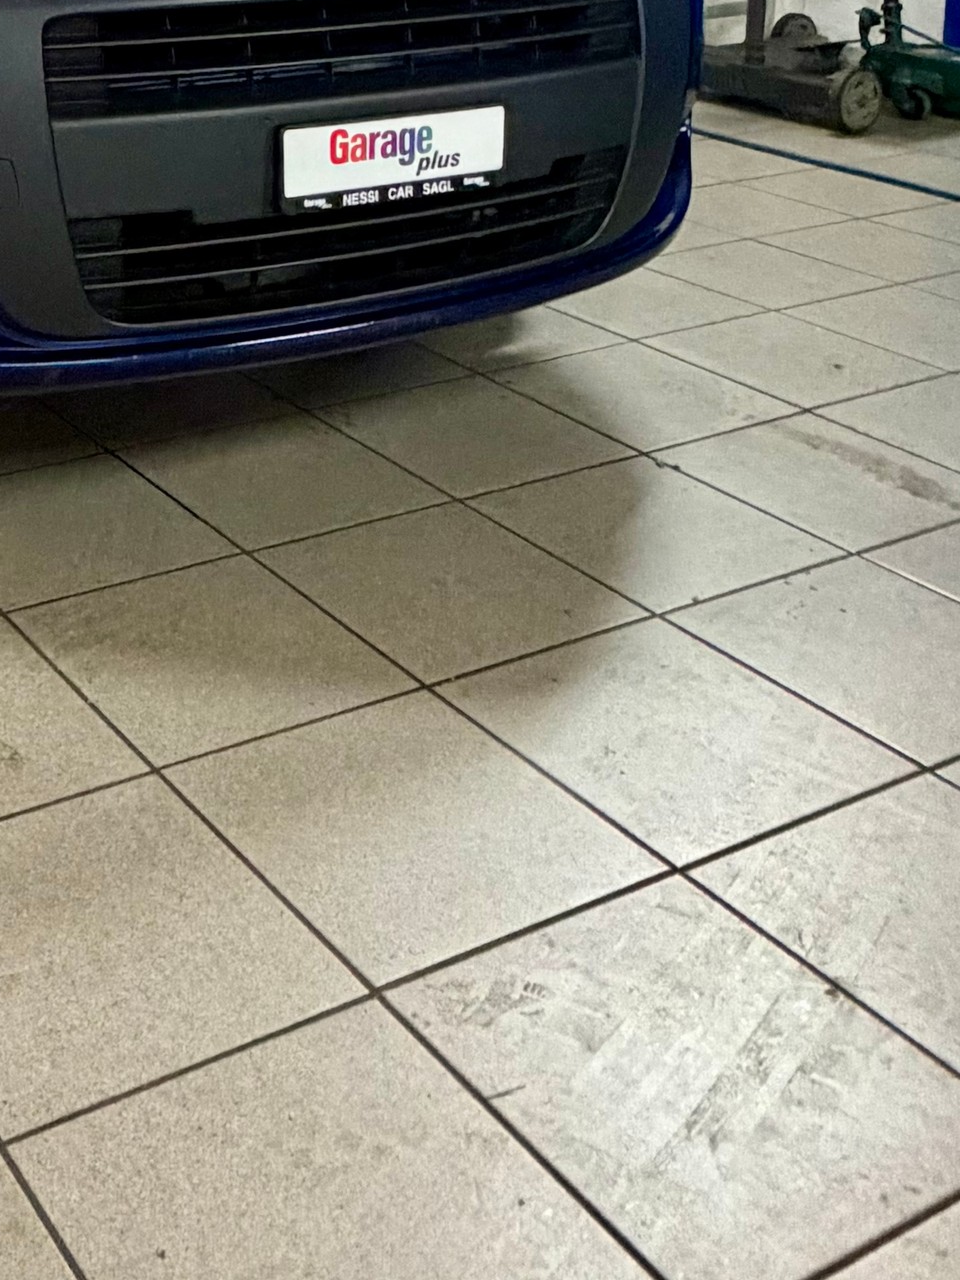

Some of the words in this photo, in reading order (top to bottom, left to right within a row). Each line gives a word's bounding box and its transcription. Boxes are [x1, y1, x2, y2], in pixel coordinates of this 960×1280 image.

[329, 125, 433, 166] Garage
[416, 150, 460, 176] plus
[343, 189, 380, 207] NESSI
[388, 185, 414, 201] CAR
[422, 180, 454, 196] SAGL
